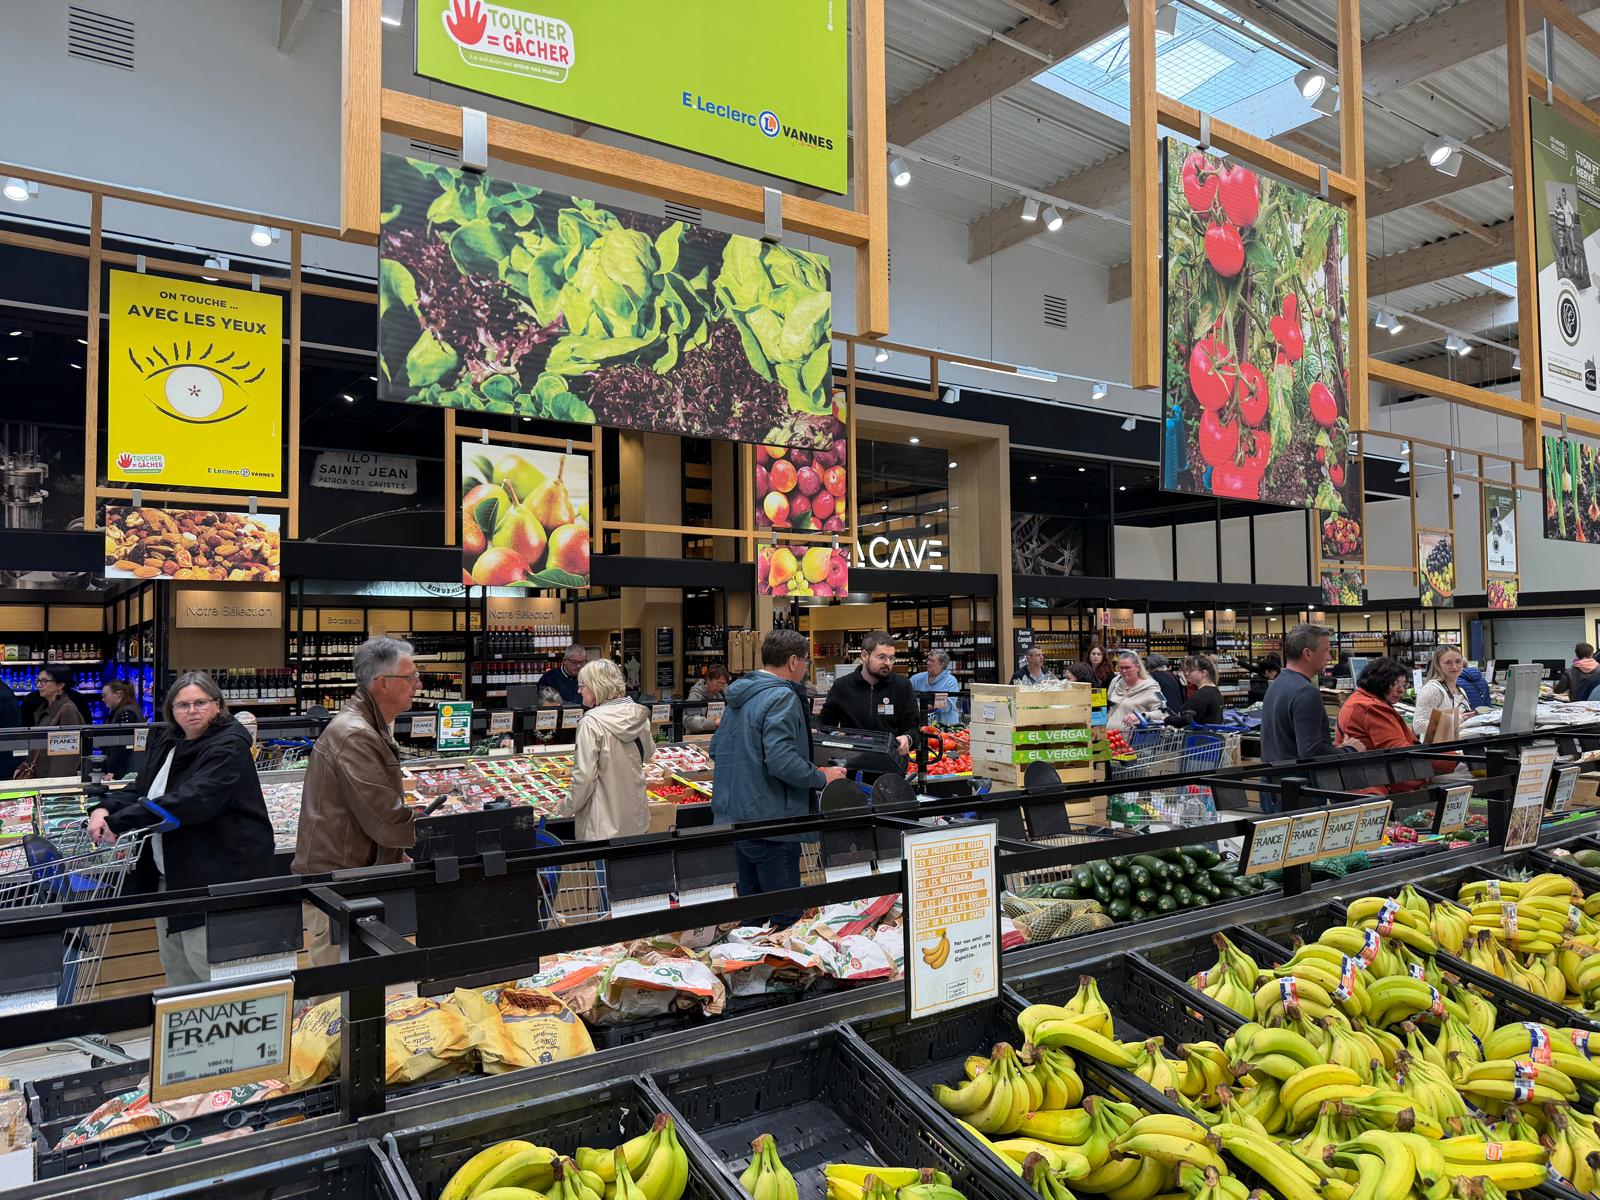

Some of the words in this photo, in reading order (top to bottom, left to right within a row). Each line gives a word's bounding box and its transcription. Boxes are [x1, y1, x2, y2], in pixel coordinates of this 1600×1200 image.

[487, 9, 567, 43] TOUCHER
[503, 31, 569, 65] GÂCHER
[513, 63, 530, 71] entre
[682, 91, 757, 127] E.Leclerc
[782, 125, 834, 151] VANNES
[159, 291, 177, 301] ON
[180, 294, 227, 308] TOUCHE
[128, 304, 179, 323] AVEC
[184, 312, 216, 328] LES
[221, 317, 267, 335] YEUX
[132, 455, 163, 463] TOUCHER
[347, 453, 378, 464] ILOT
[319, 464, 361, 476] SAINT
[368, 467, 408, 479] JEAN
[319, 476, 348, 486] PATRON
[351, 479, 365, 487] DES
[368, 480, 406, 490] CAVISTES
[868, 537, 943, 570] CAVE
[186, 606, 218, 617] Notre
[50, 738, 78, 746] FRANCE
[1028, 731, 1042, 741] EL
[1046, 729, 1089, 741] VERGAL
[1028, 751, 1043, 760] EL
[1046, 748, 1090, 760] VERGAL
[916, 859, 926, 868] LES
[928, 857, 946, 866] FRUITS
[957, 853, 965, 861] LES
[916, 880, 927, 888] PAS
[928, 878, 938, 886] LES
[926, 900, 936, 908] LES
[938, 896, 954, 905] LAVER
[917, 909, 935, 919] CLAIRE
[957, 903, 967, 911] LES
[168, 1000, 257, 1029] BANANE
[168, 1013, 278, 1049] FRANCE
